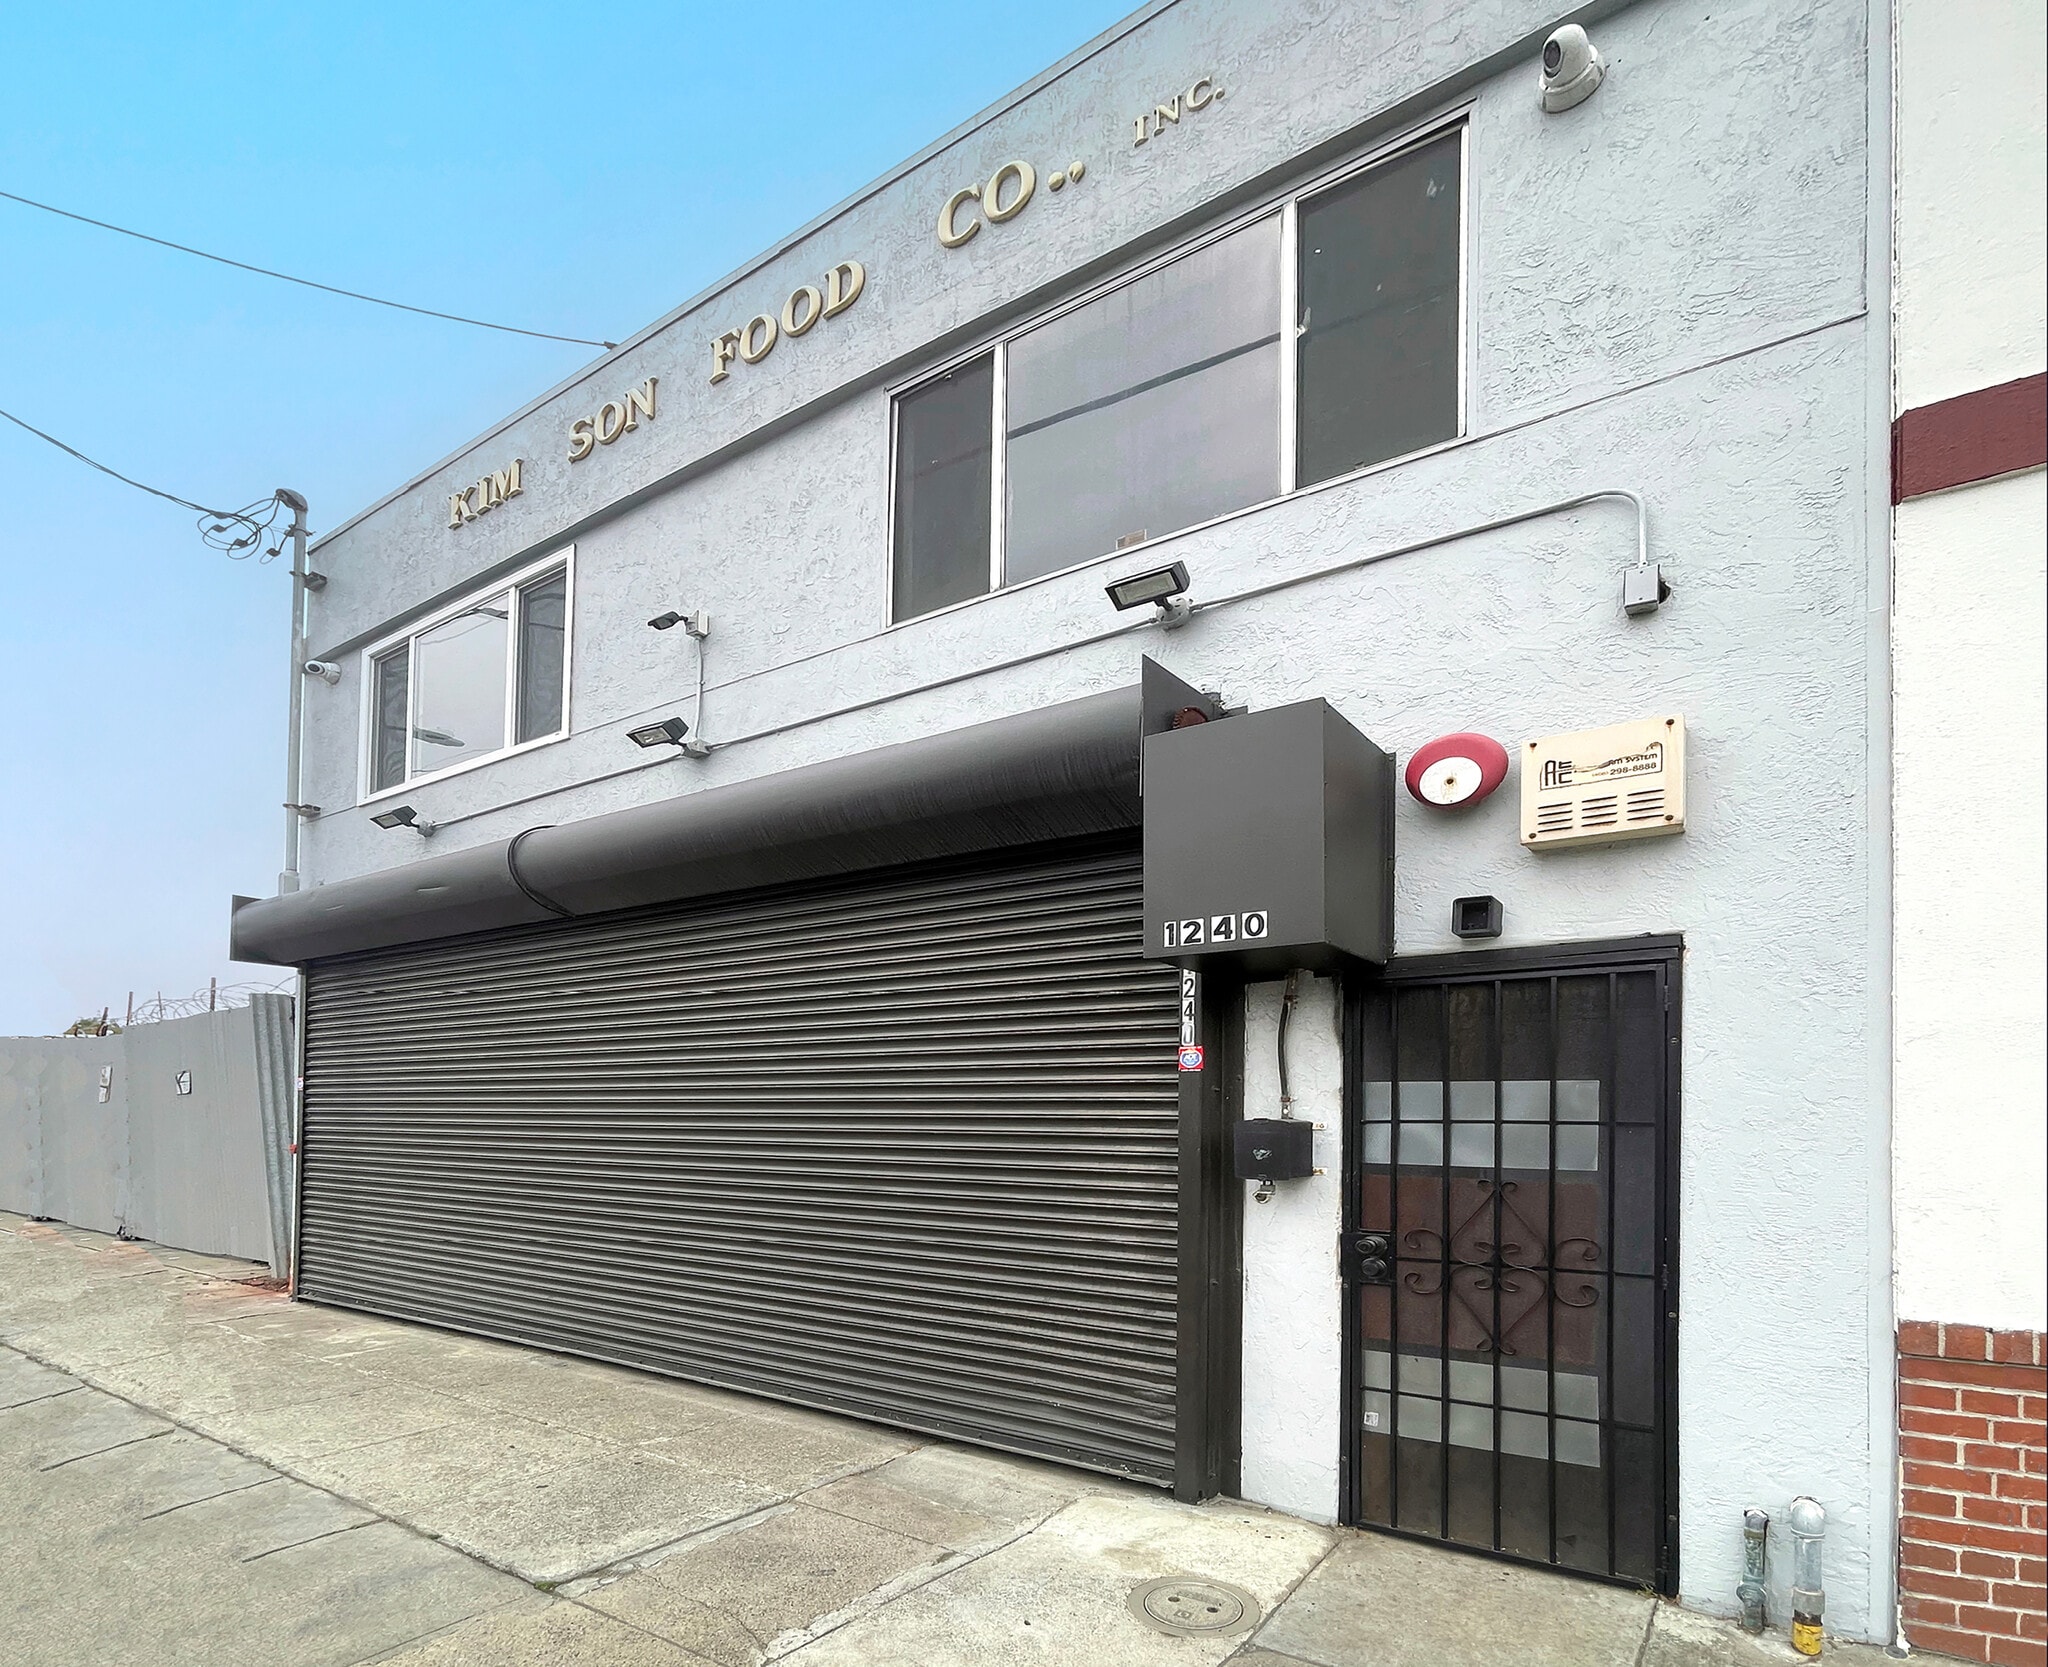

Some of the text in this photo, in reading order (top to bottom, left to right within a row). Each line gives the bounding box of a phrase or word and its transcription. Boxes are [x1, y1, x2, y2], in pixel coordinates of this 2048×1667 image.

[447, 458, 525, 530] KIM
[567, 376, 659, 464] SON
[709, 260, 866, 385] FOOD
[1133, 76, 1226, 149] INC.
[1609, 762, 1657, 776] 298-8888
[1625, 753, 1658, 763] SYSTEM
[1164, 912, 1266, 946] 1240
[1181, 969, 1196, 1045] 240
